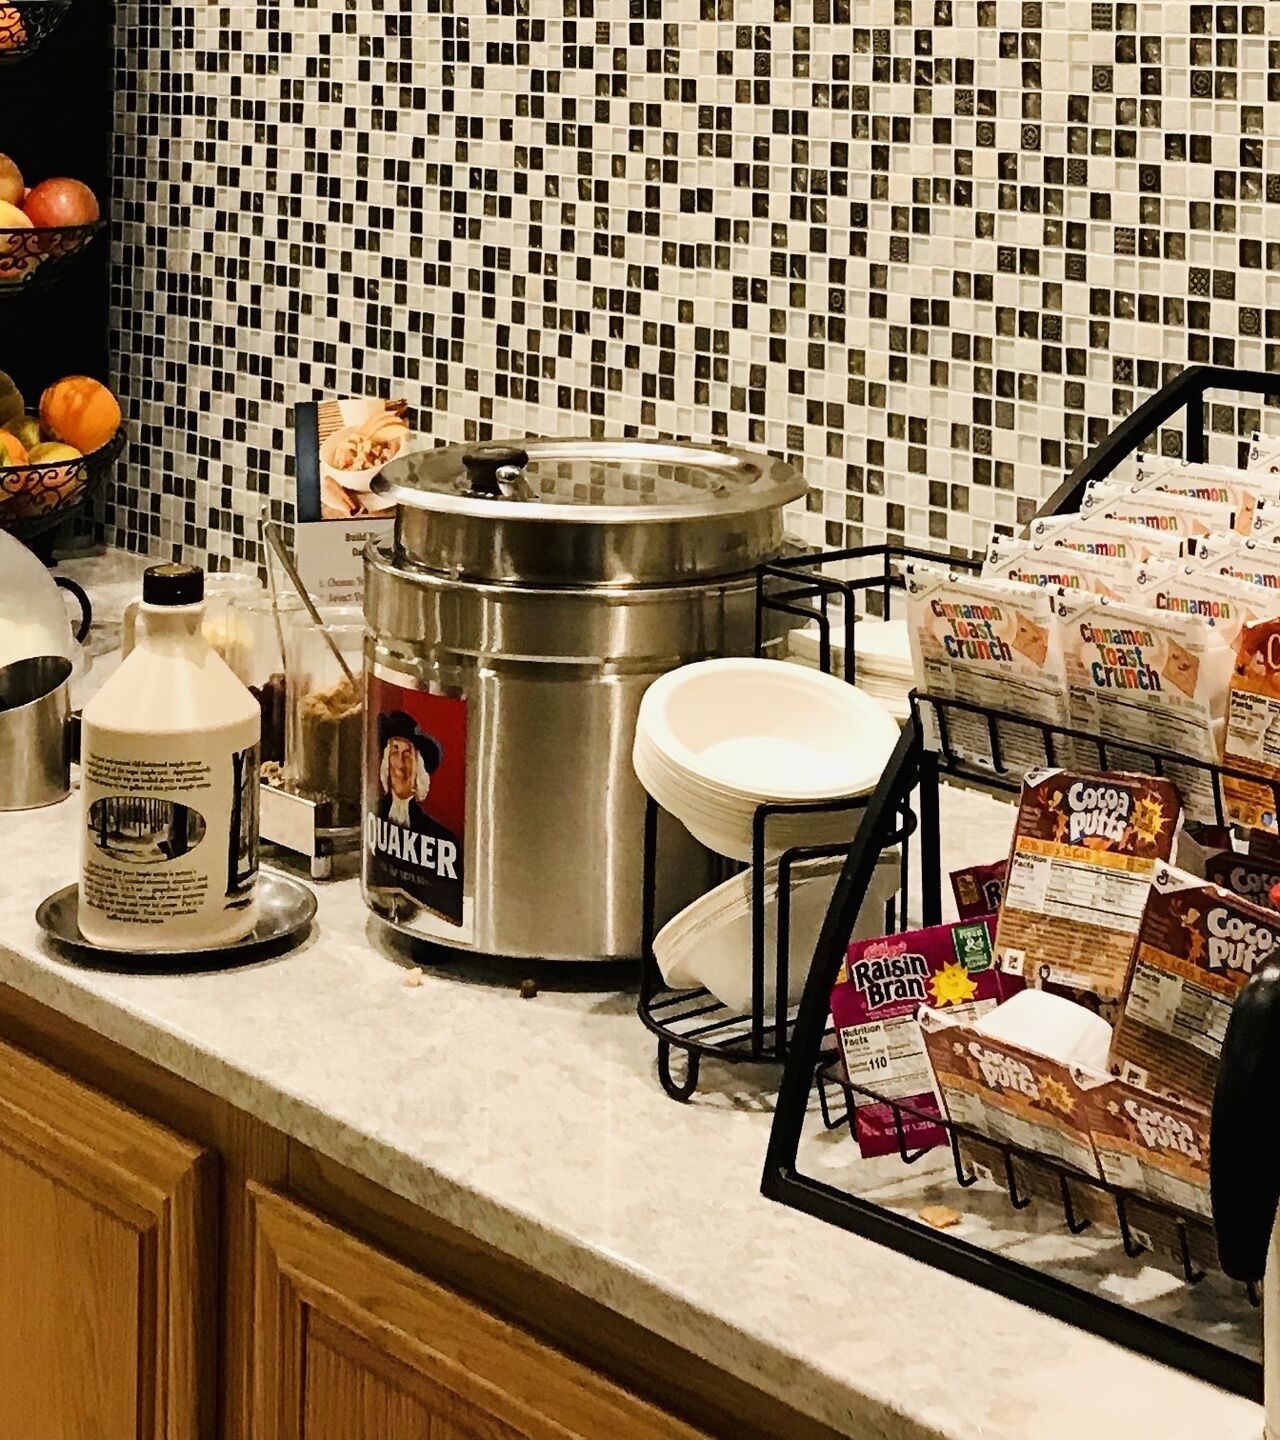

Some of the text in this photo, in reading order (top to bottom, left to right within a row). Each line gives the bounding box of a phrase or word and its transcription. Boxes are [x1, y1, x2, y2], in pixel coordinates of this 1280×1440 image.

[345, 532, 366, 542] Build
[930, 598, 1003, 621] Cinnamon
[1156, 590, 1230, 620] Cinnamon
[947, 618, 995, 640] Toast
[1079, 622, 1155, 647] Cinnamon
[944, 634, 1013, 662] Crunch
[1095, 643, 1145, 668] Toast
[1091, 661, 1163, 691] Crunch
[1231, 691, 1267, 705] Nutrition
[1231, 700, 1253, 711] Facts
[1068, 782, 1130, 817] Cocoa
[367, 811, 458, 880] QUAKER
[1015, 851, 1048, 864] Nutrition
[1014, 860, 1034, 870] Facts
[1230, 867, 1280, 893] Coco
[1208, 937, 1273, 973] Puf
[854, 954, 930, 990] Raisin
[866, 977, 926, 1008] Bran
[842, 1024, 881, 1038] Nutrition
[844, 1036, 869, 1047] Facts
[868, 1056, 888, 1071] 110
